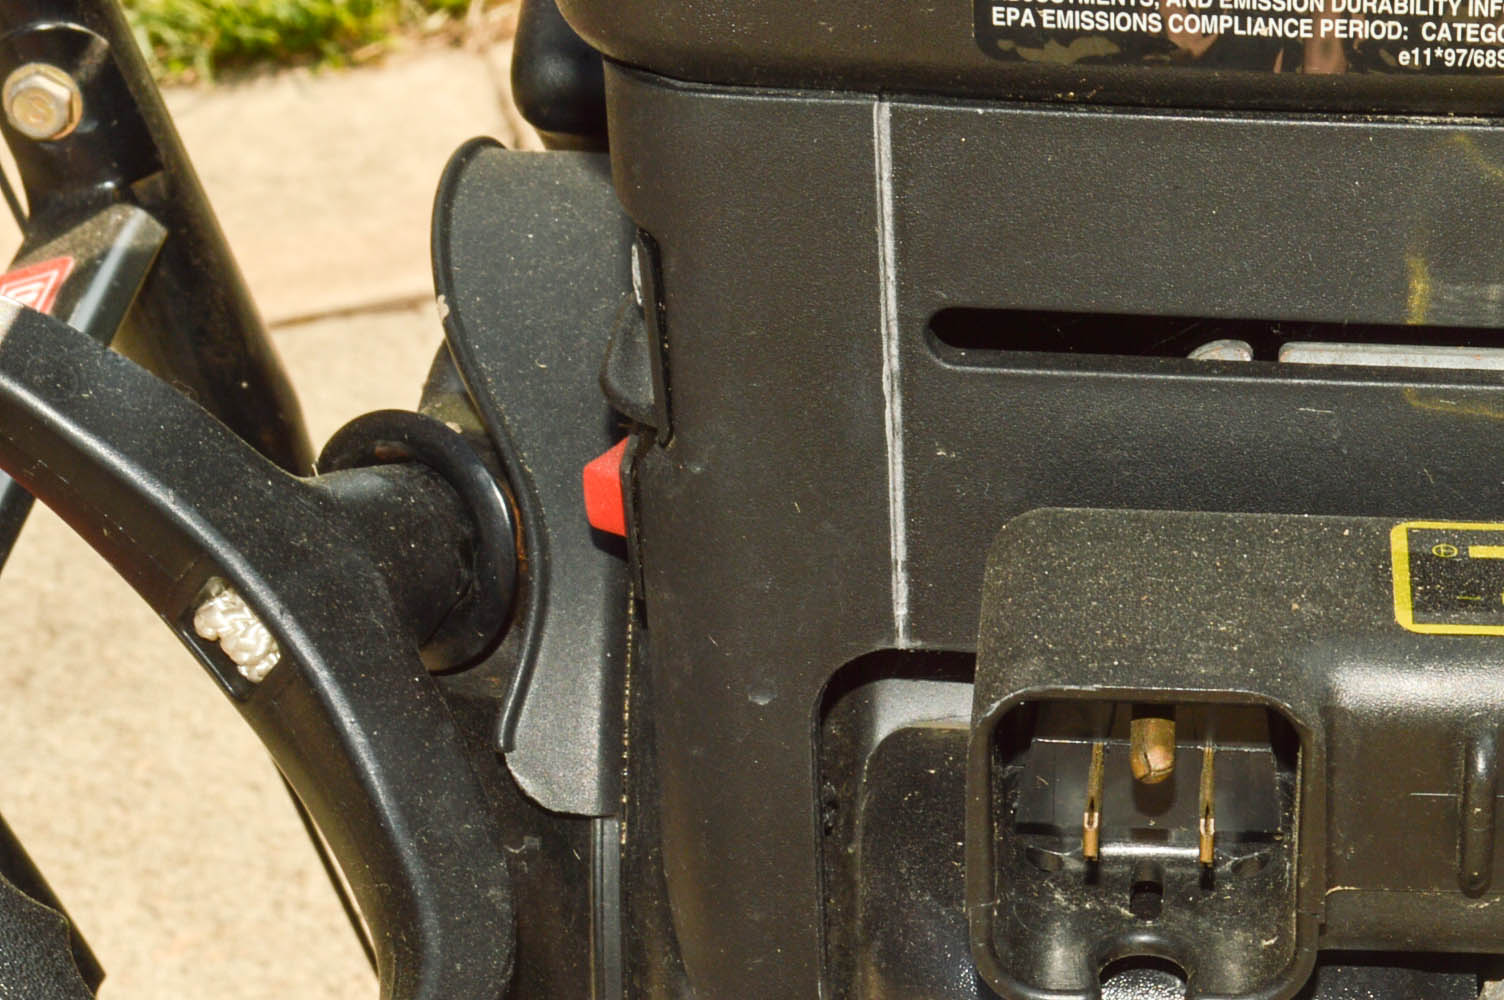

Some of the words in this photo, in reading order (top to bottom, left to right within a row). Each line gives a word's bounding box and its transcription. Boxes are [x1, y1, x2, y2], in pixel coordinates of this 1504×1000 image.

[991, 6, 1036, 28] EPA
[1042, 9, 1162, 33] EMISSIONS
[1168, 13, 1312, 38] COMPLIANCE
[1320, 17, 1409, 41] PERIOD:
